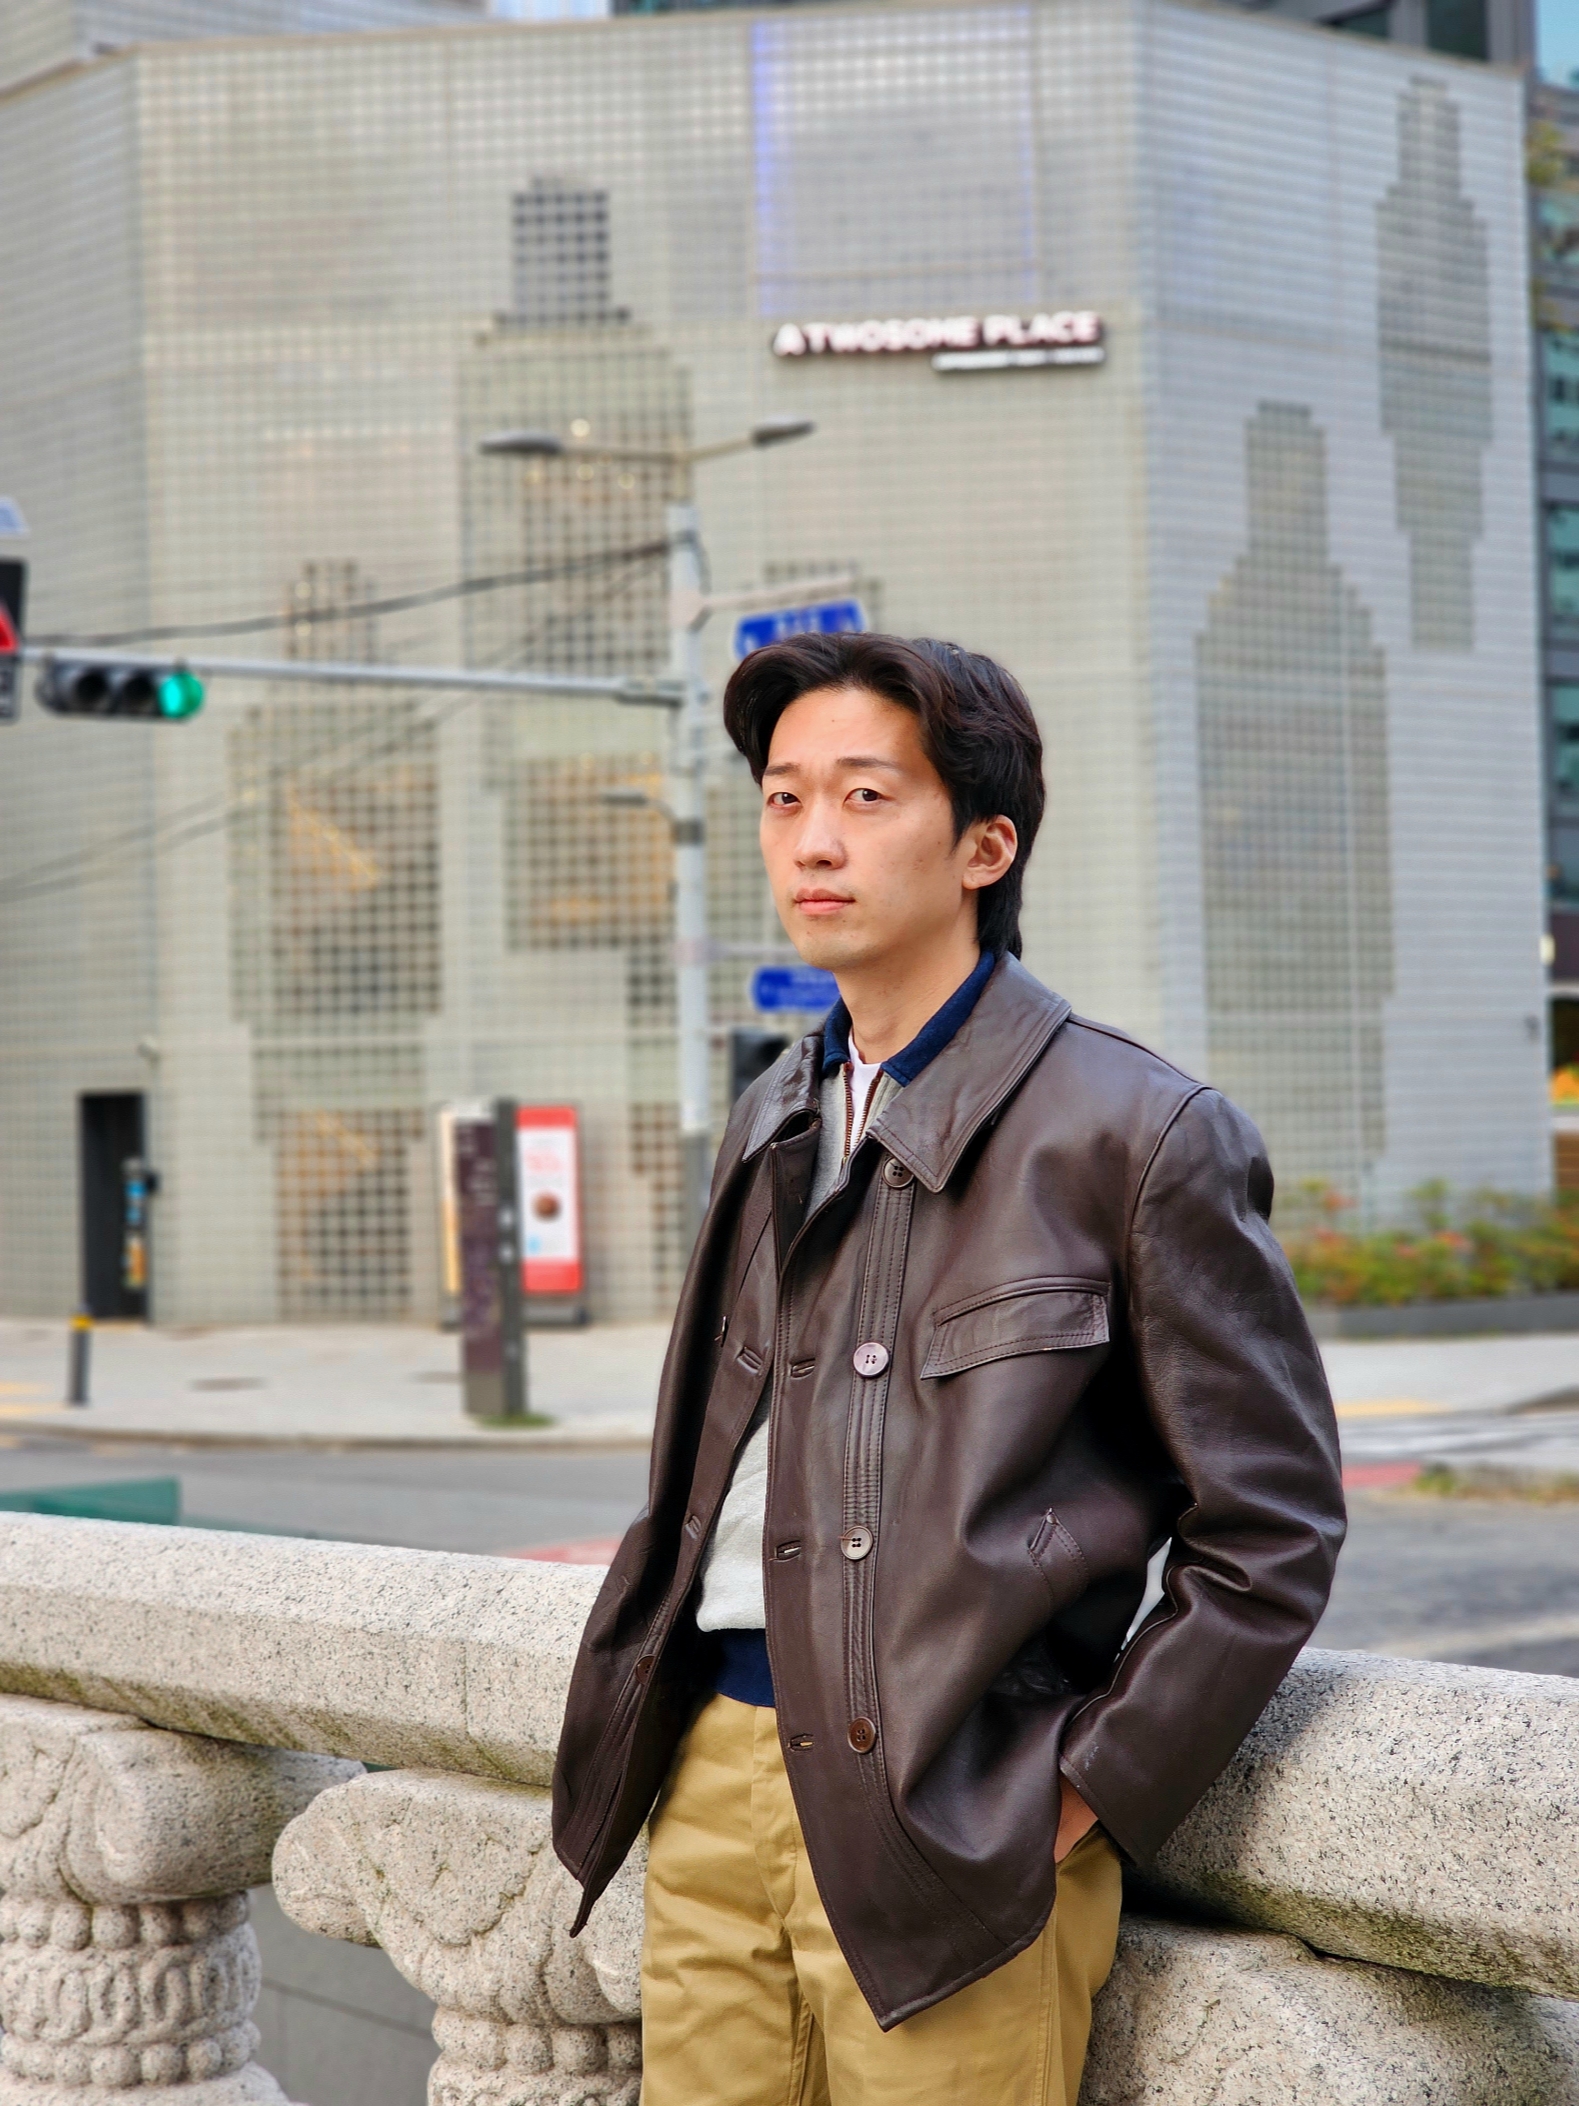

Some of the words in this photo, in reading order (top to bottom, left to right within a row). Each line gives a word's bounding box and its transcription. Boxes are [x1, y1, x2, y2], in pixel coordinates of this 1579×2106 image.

[773, 323, 805, 357] A
[804, 317, 979, 353] TWOSOME
[983, 312, 1100, 346] PLACE
